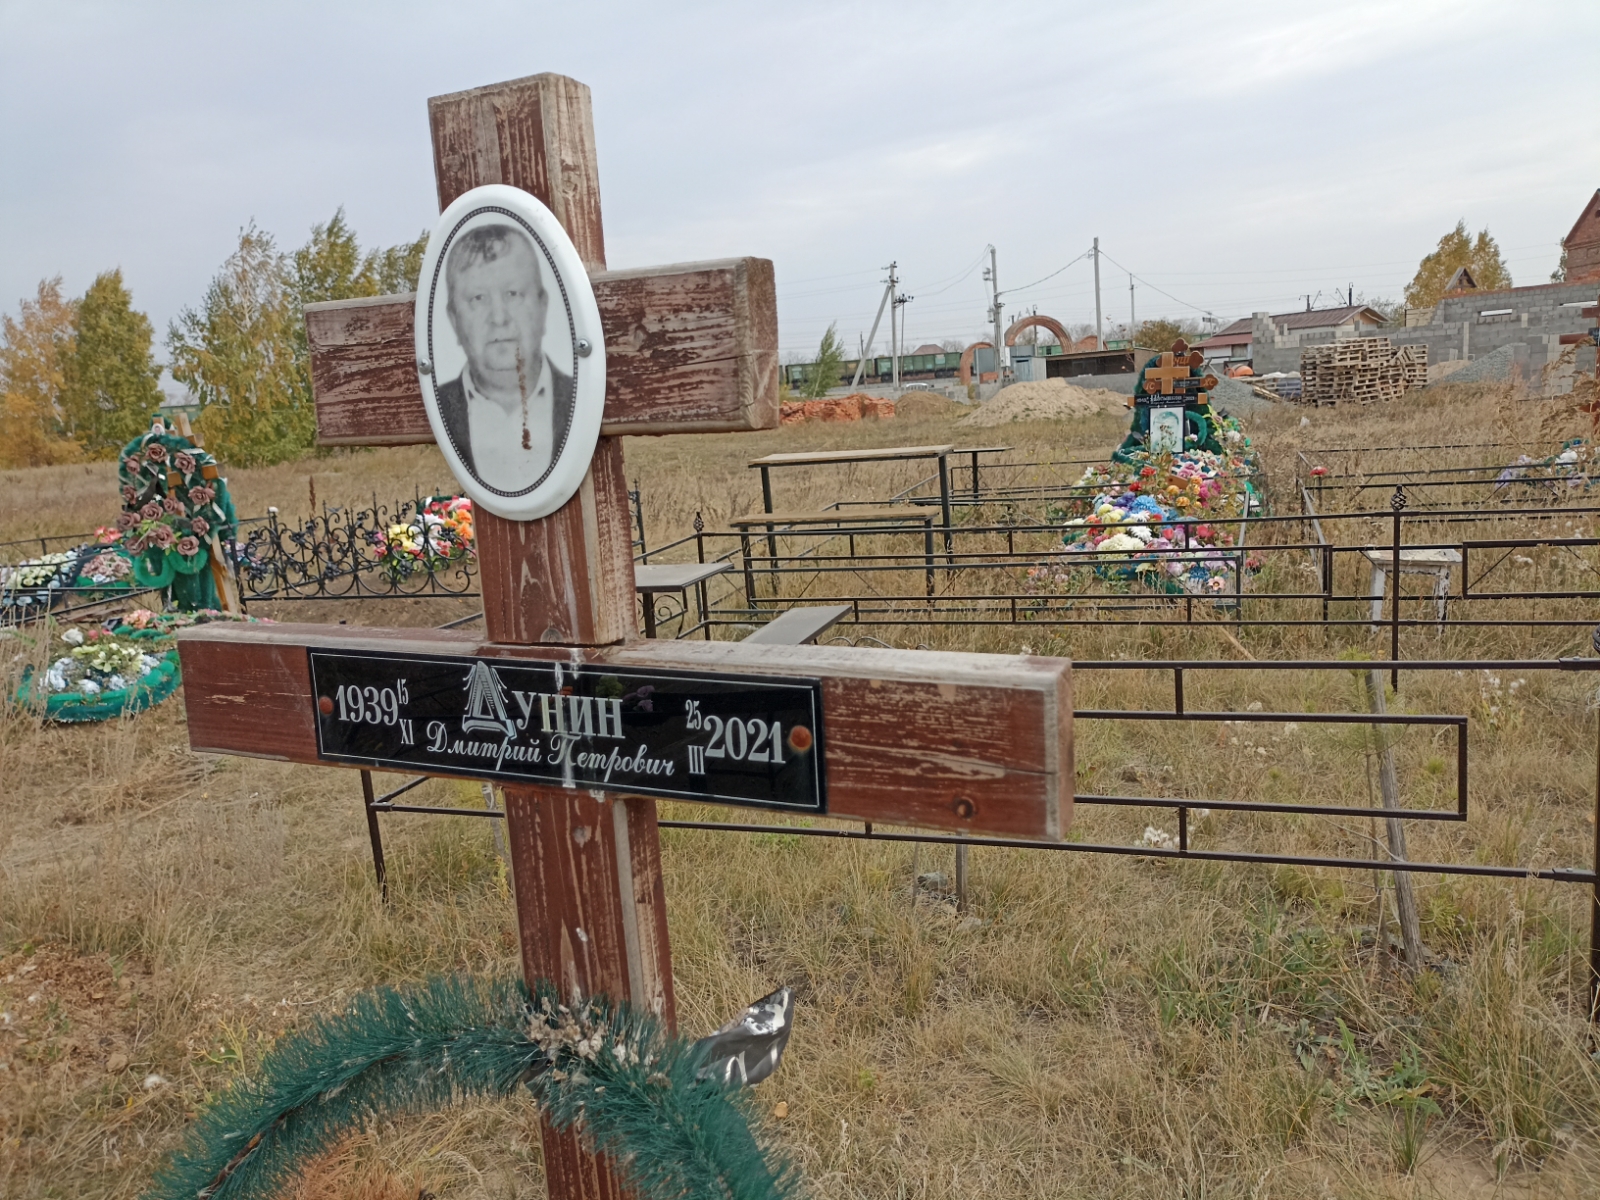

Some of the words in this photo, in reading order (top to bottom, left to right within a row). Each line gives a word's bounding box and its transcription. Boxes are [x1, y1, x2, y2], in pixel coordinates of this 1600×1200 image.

[336, 685, 399, 726] 1939
[397, 678, 409, 705] 15
[685, 699, 702, 730] 25
[399, 718, 415, 746] XI
[704, 715, 786, 764] 2021
[426, 720, 542, 772] Дмитрий
[548, 733, 675, 783] Петрович
[687, 744, 706, 775] III
